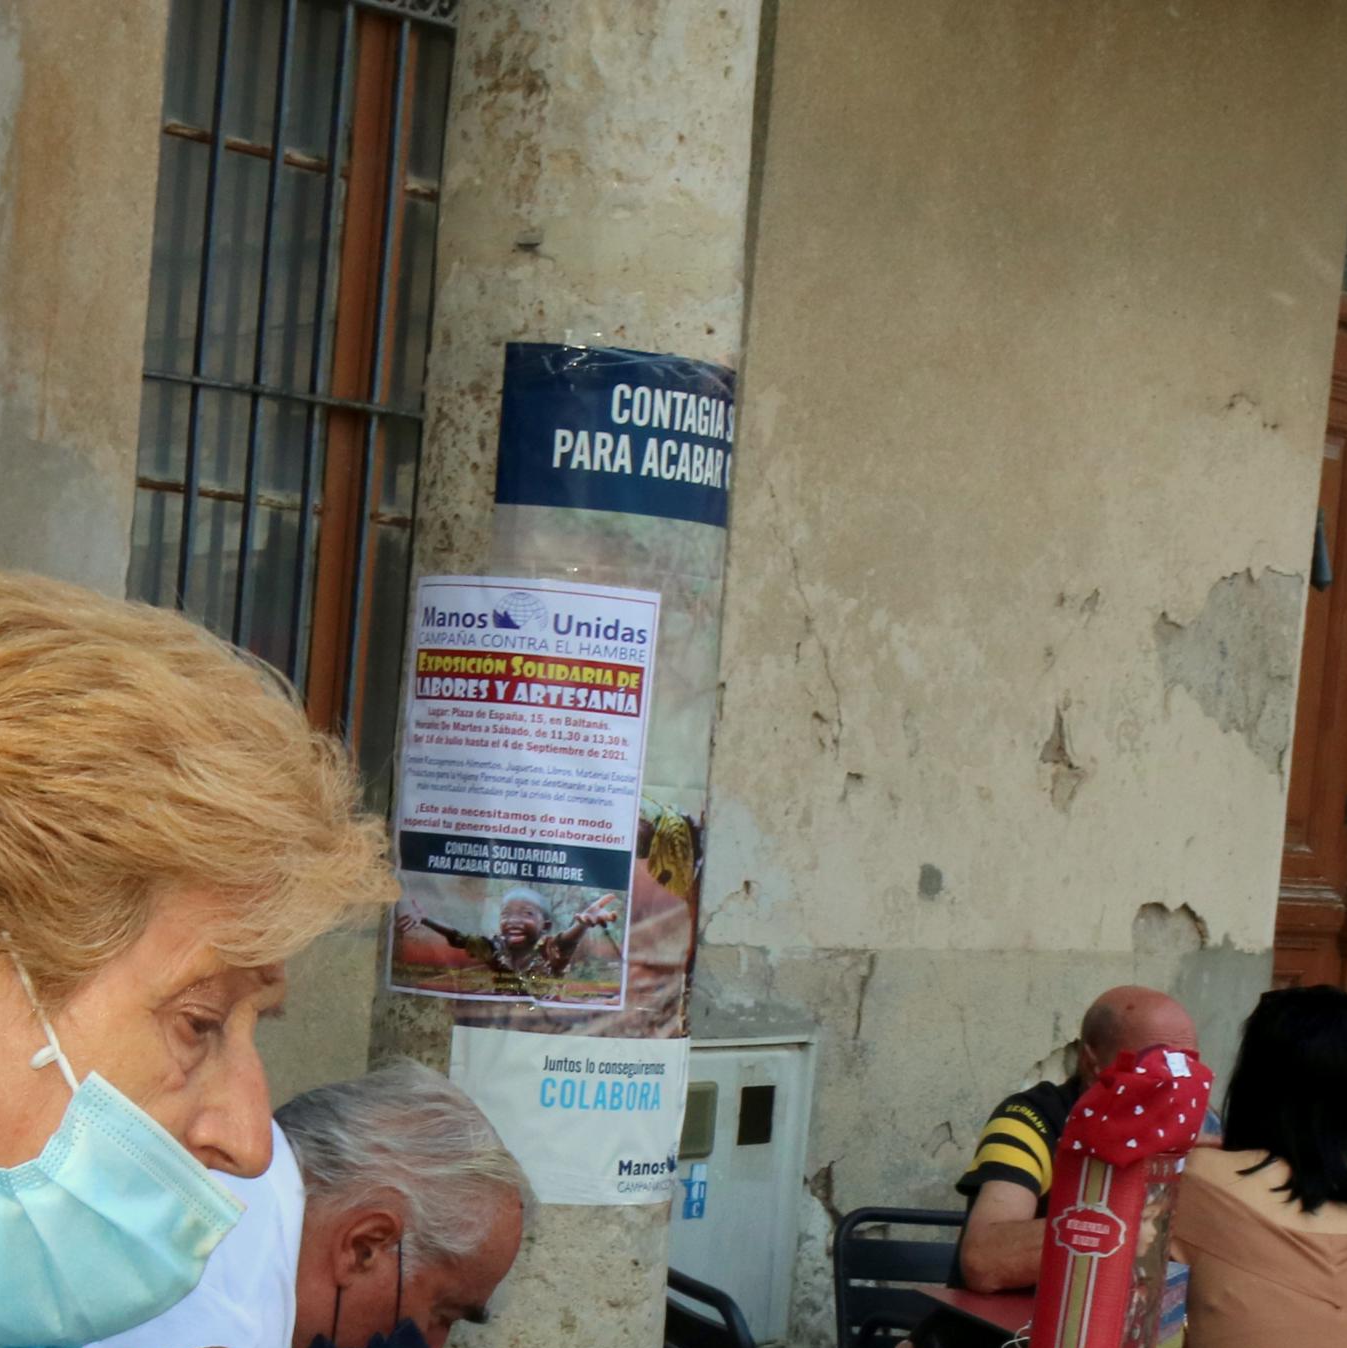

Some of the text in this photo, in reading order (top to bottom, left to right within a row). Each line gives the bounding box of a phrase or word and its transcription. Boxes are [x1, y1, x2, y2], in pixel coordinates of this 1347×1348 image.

[611, 383, 725, 440] CONTAGIA
[553, 429, 632, 475] PARA
[640, 438, 724, 488] ACABAR
[422, 606, 648, 644] Manos Unidas
[418, 631, 646, 663] CAMPAÑA CONTRA EL HAMBRE
[616, 672, 641, 689] DE
[416, 677, 638, 715] LABORES Y ARTESANÍA
[452, 707, 473, 718] Plaza
[476, 709, 486, 719] de
[549, 717, 562, 726] en
[453, 722, 482, 733] Martes
[484, 725, 490, 733] a
[535, 728, 548, 738] de
[583, 735, 589, 743] a
[464, 736, 489, 748] hasta
[491, 739, 500, 748] el
[502, 740, 509, 749] 4
[511, 740, 524, 750] de
[526, 741, 583, 757] Septiembre
[587, 747, 600, 757] de
[442, 805, 459, 815] año
[461, 807, 538, 823] necesitamos
[540, 812, 555, 823] de
[559, 816, 574, 826] un
[578, 817, 612, 829] modo
[442, 820, 452, 829] tu
[454, 820, 526, 836] generosidad
[529, 828, 536, 837] y
[539, 828, 625, 845] colaboración!
[445, 841, 567, 864] CONTAGIA SOLIDARIDAD
[428, 854, 584, 882] PARA ACABAR CON EL HAMBRE
[543, 1055, 666, 1079] Juntos lo conseguiremos
[539, 1077, 661, 1111] COLABORA
[1005, 1104, 1048, 1134] GERMANY
[618, 1160, 666, 1176] Manos
